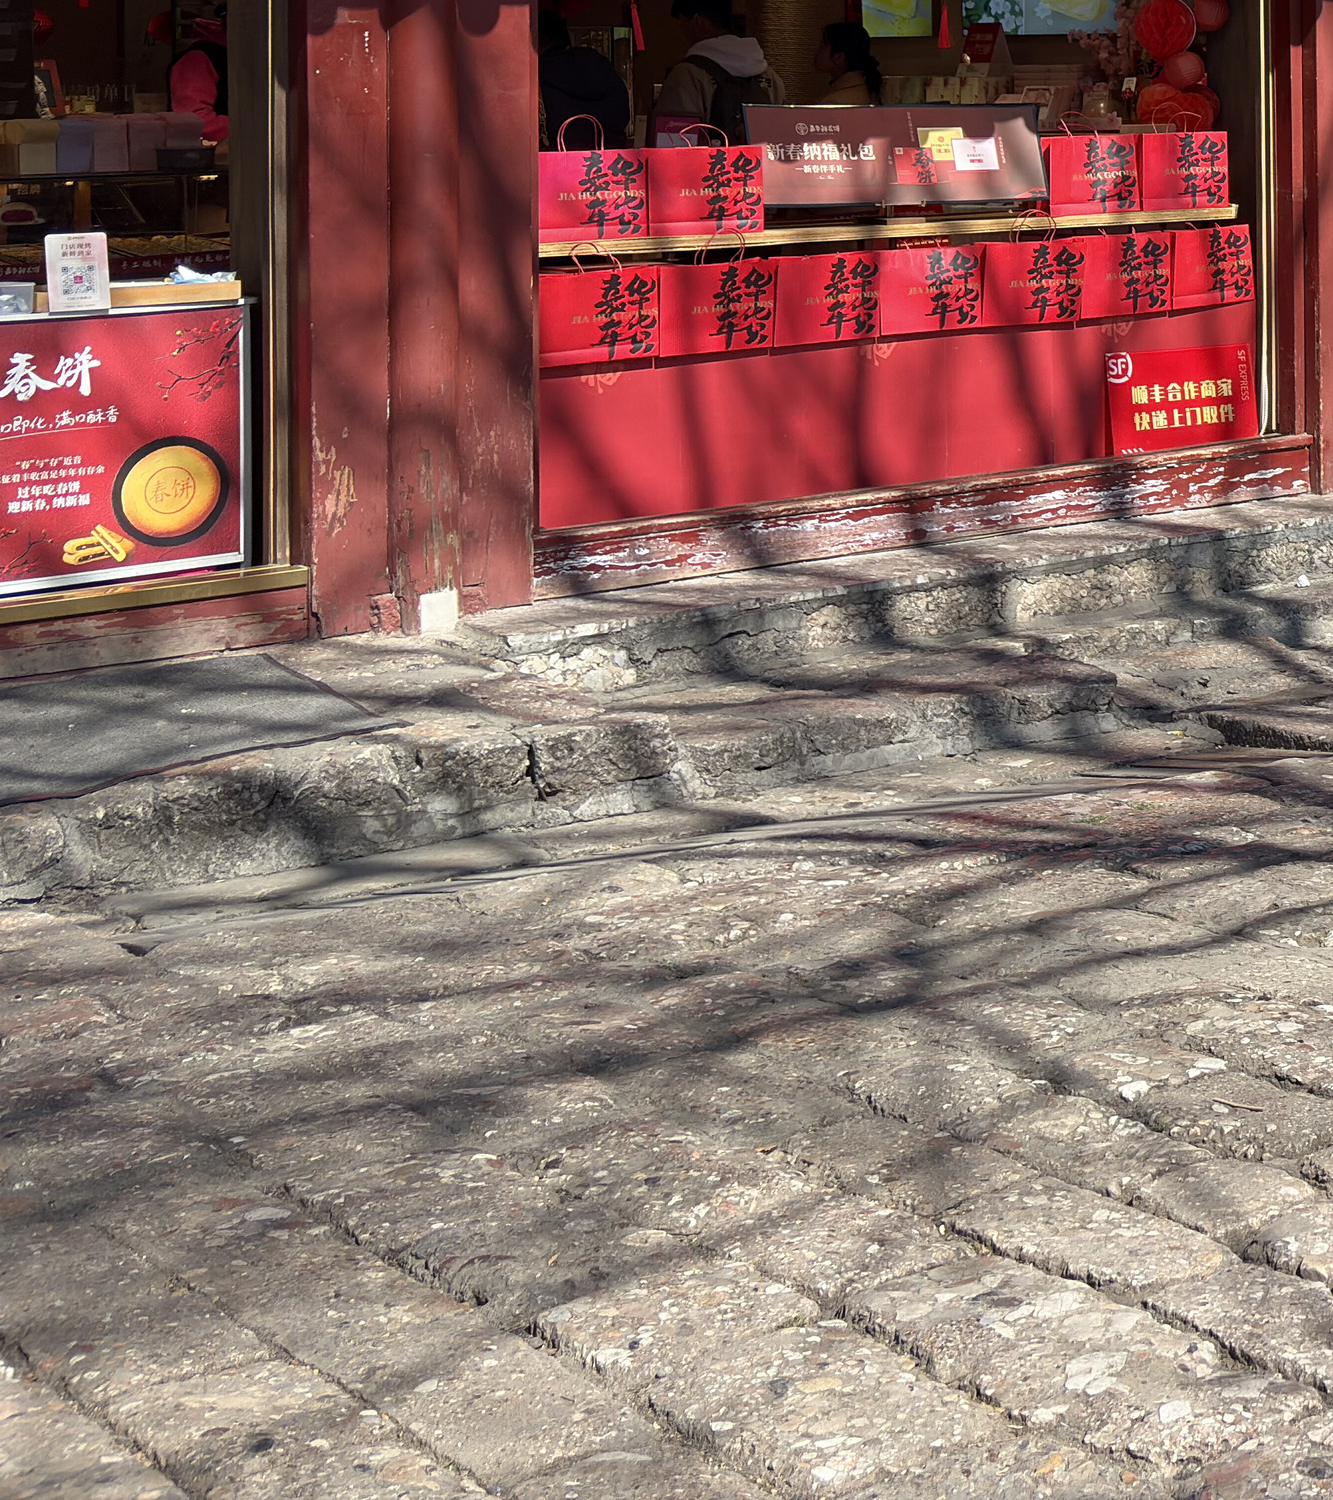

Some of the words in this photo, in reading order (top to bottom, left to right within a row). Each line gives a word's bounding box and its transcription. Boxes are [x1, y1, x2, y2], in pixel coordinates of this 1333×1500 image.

[766, 143, 876, 161] 新春纳福礼包
[578, 151, 644, 194] 嘉华
[702, 149, 761, 193] 嘉华
[1103, 168, 1137, 179] GOODS
[558, 192, 576, 201] JIA
[604, 189, 645, 200] GOODS
[679, 188, 697, 197] JIA
[580, 194, 645, 239] 年货
[699, 192, 762, 232] 年货
[1108, 358, 1126, 376] SF
[1237, 349, 1246, 362] SF
[0, 346, 101, 401] 春饼
[1238, 363, 1250, 401] EXPRESS
[1131, 378, 1232, 405] 顺丰合作商家
[1133, 404, 1235, 431] 快递上门取件
[0, 465, 105, 484] 征着丰收富足年年有存余
[17, 480, 81, 499] 过年吃春饼
[151, 477, 193, 504] 春饼
